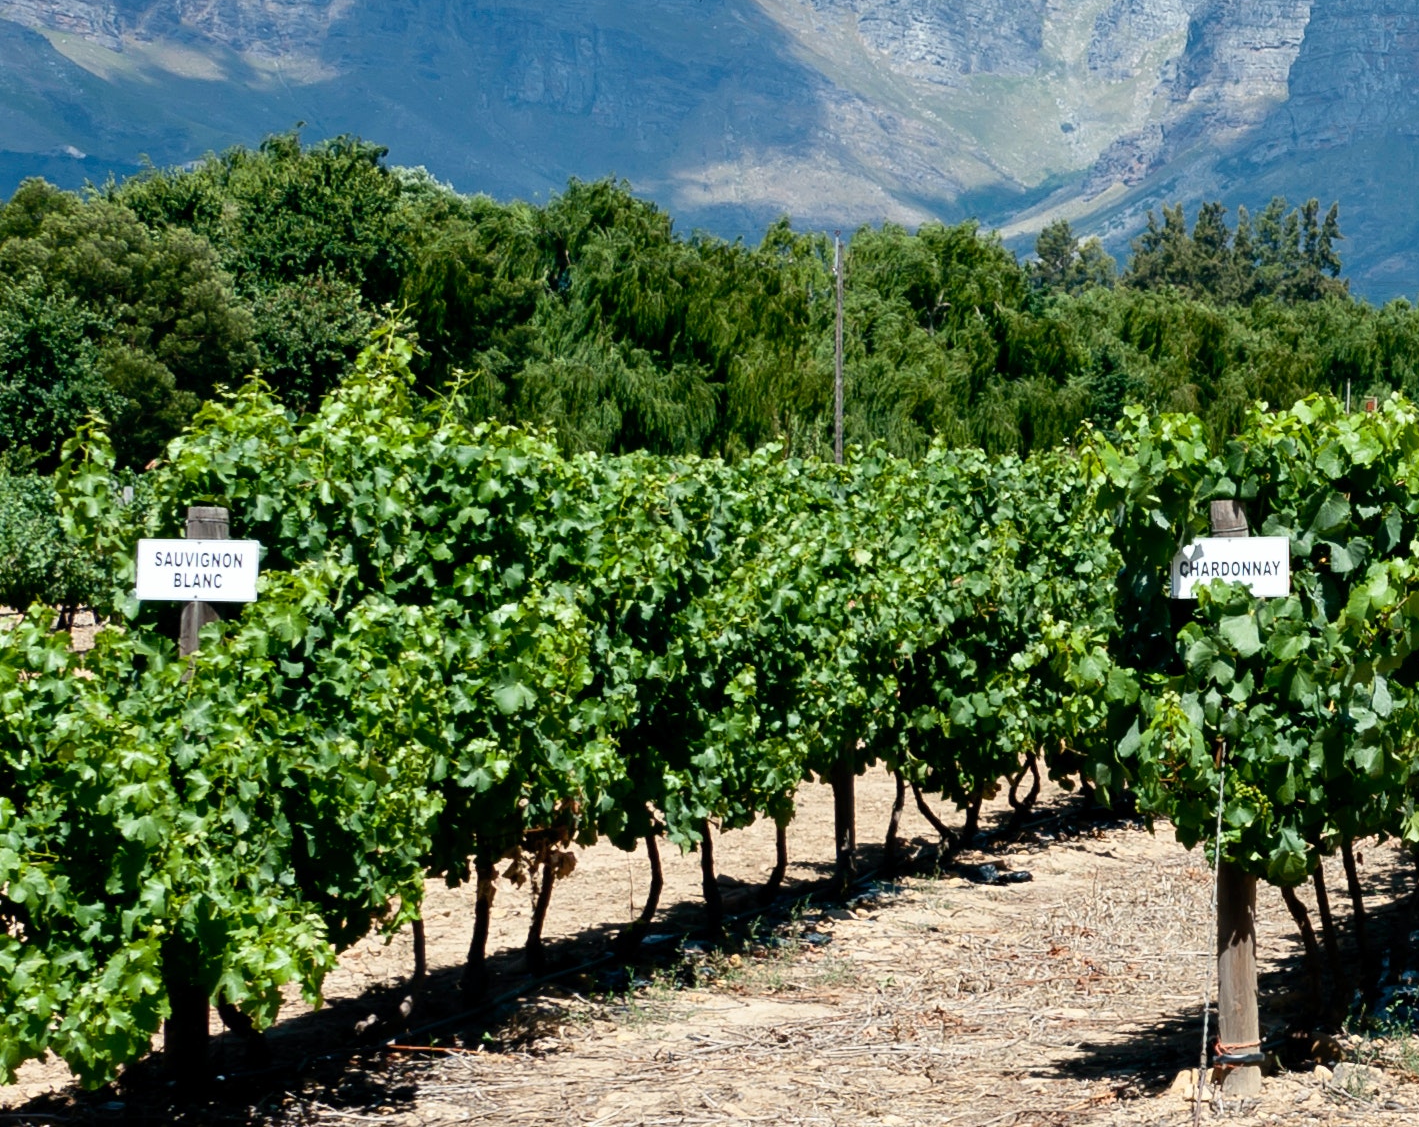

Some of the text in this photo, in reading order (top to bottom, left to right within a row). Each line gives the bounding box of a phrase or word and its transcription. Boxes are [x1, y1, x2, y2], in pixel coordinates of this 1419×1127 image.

[155, 551, 243, 568] SAUVIGNON
[1180, 560, 1281, 577] CHARDONNAY
[173, 572, 223, 589] BLANC
